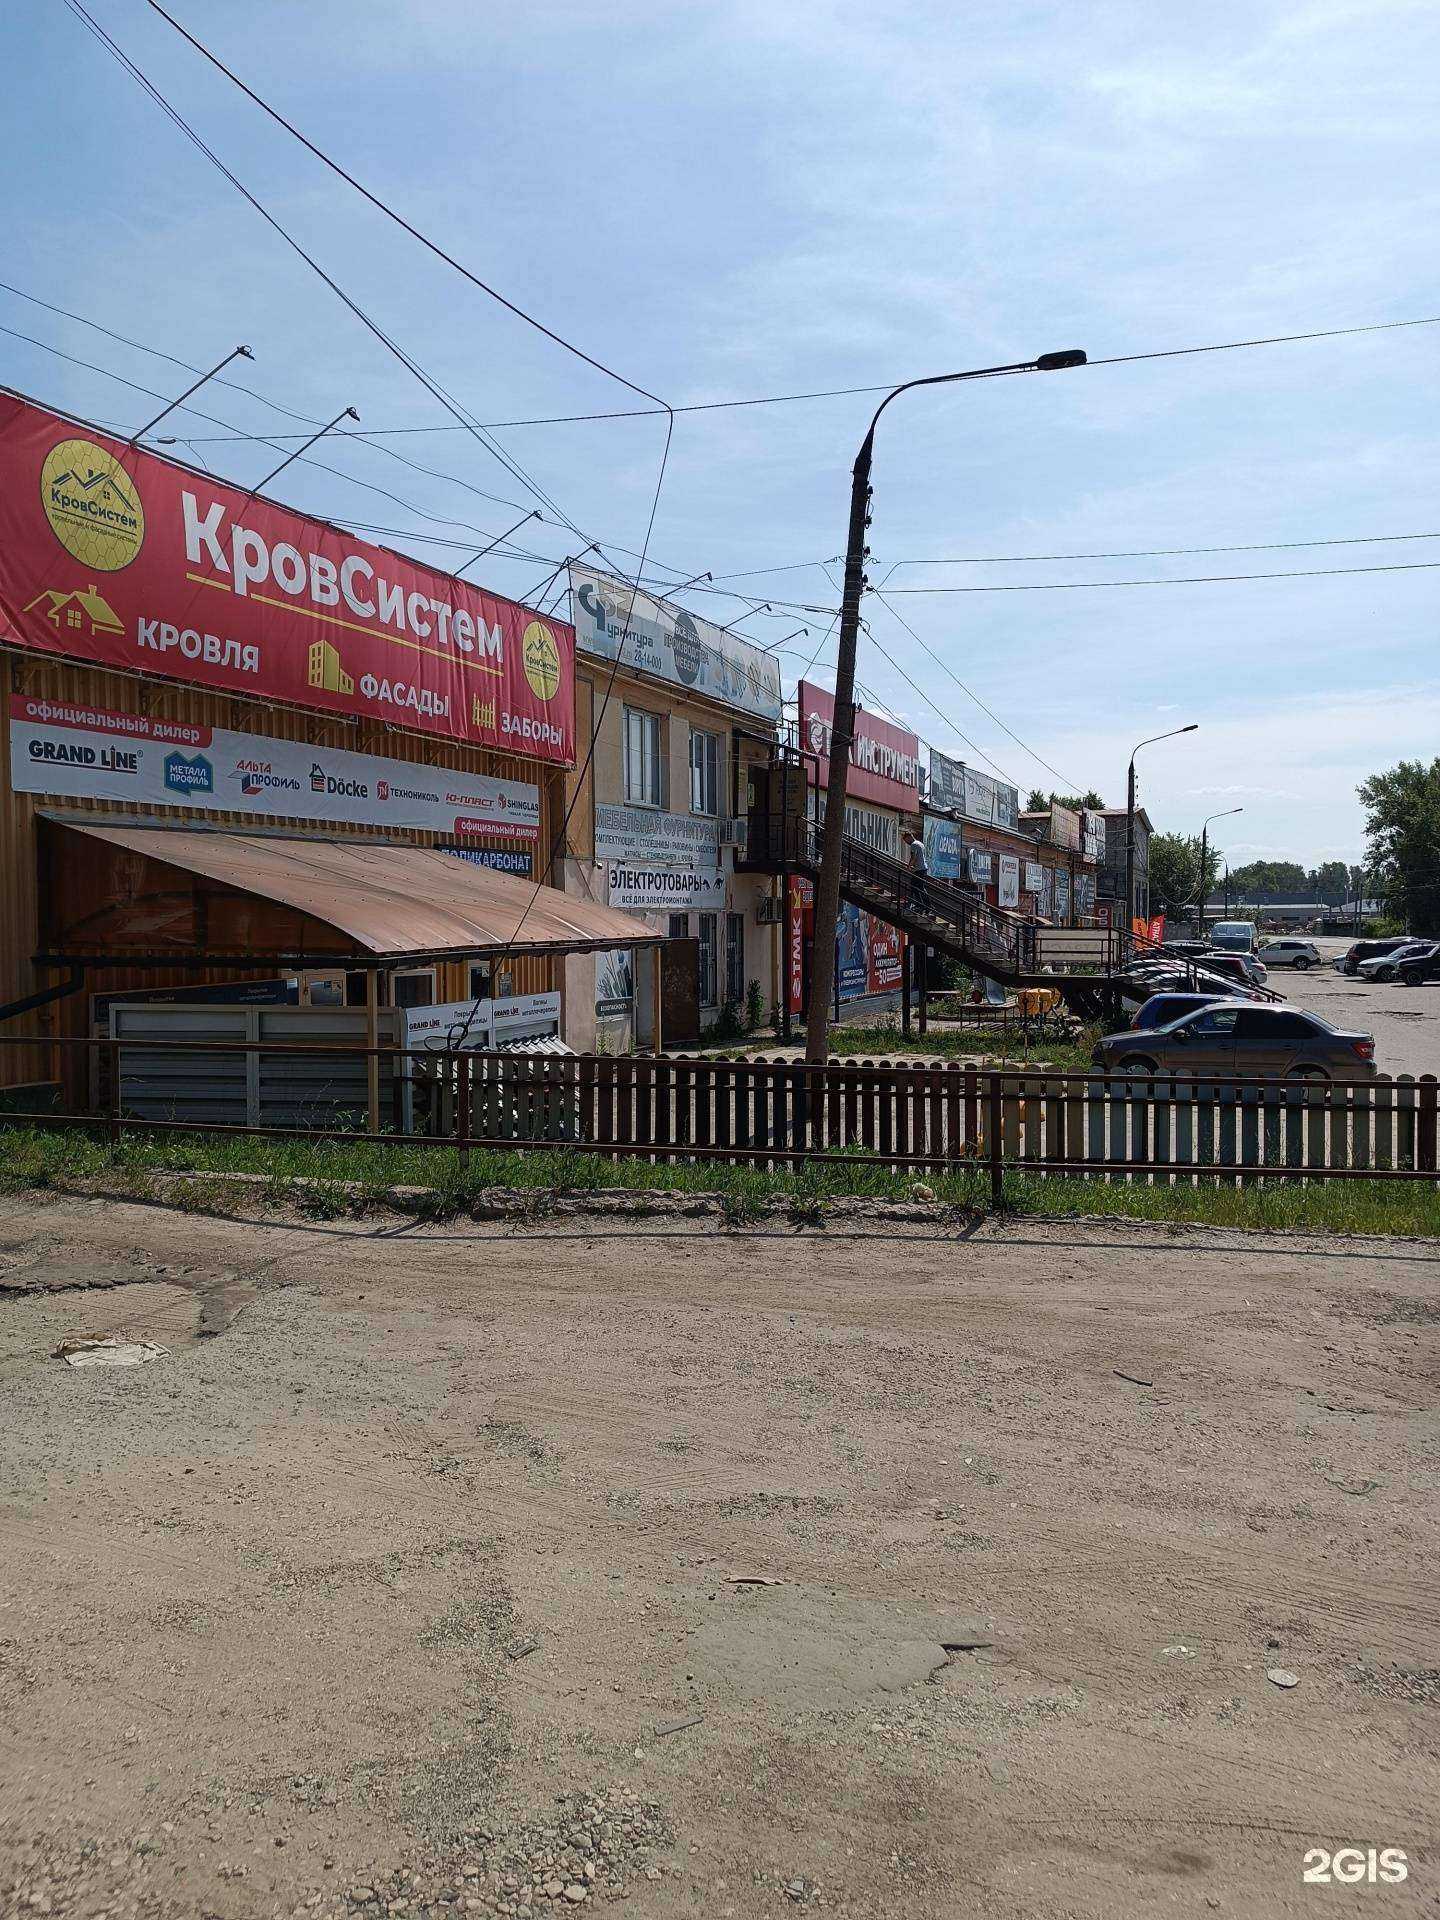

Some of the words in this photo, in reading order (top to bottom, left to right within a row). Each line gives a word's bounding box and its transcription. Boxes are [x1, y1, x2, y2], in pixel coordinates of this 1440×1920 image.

[52, 487, 137, 528] КровСистем
[182, 490, 503, 663] КровСистем
[137, 617, 259, 673] КРОВЛЯ
[360, 673, 449, 717] ФАСАДЫ
[26, 701, 150, 734] официальный
[153, 724, 200, 743] дилер
[501, 712, 563, 746] ЗАБОРЫ
[28, 739, 96, 764] GRAND
[857, 732, 919, 788] ИНСТРУМЕНТ
[169, 763, 207, 777] МЕТАЛЛ
[236, 760, 272, 774] АЛЬТА
[170, 773, 209, 786] ПРОФИЛЬ
[251, 774, 300, 791] ПРОФИЛЬ
[327, 776, 368, 799] Döcke
[390, 787, 439, 803] ТЕХНОНИКОЛЬ
[507, 799, 539, 812] SHINGLAS
[461, 819, 515, 835] официальный
[516, 828, 538, 840] дилер
[595, 807, 661, 835] МЕБЕЛЬНАЯ
[610, 869, 702, 892] ЭЛЕКТРОТОВАРЫ
[634, 897, 645, 905] ДЛЯ
[646, 896, 693, 905] ЭЛЕКТРОМОНТАЖА
[409, 1021, 429, 1031] GRAND
